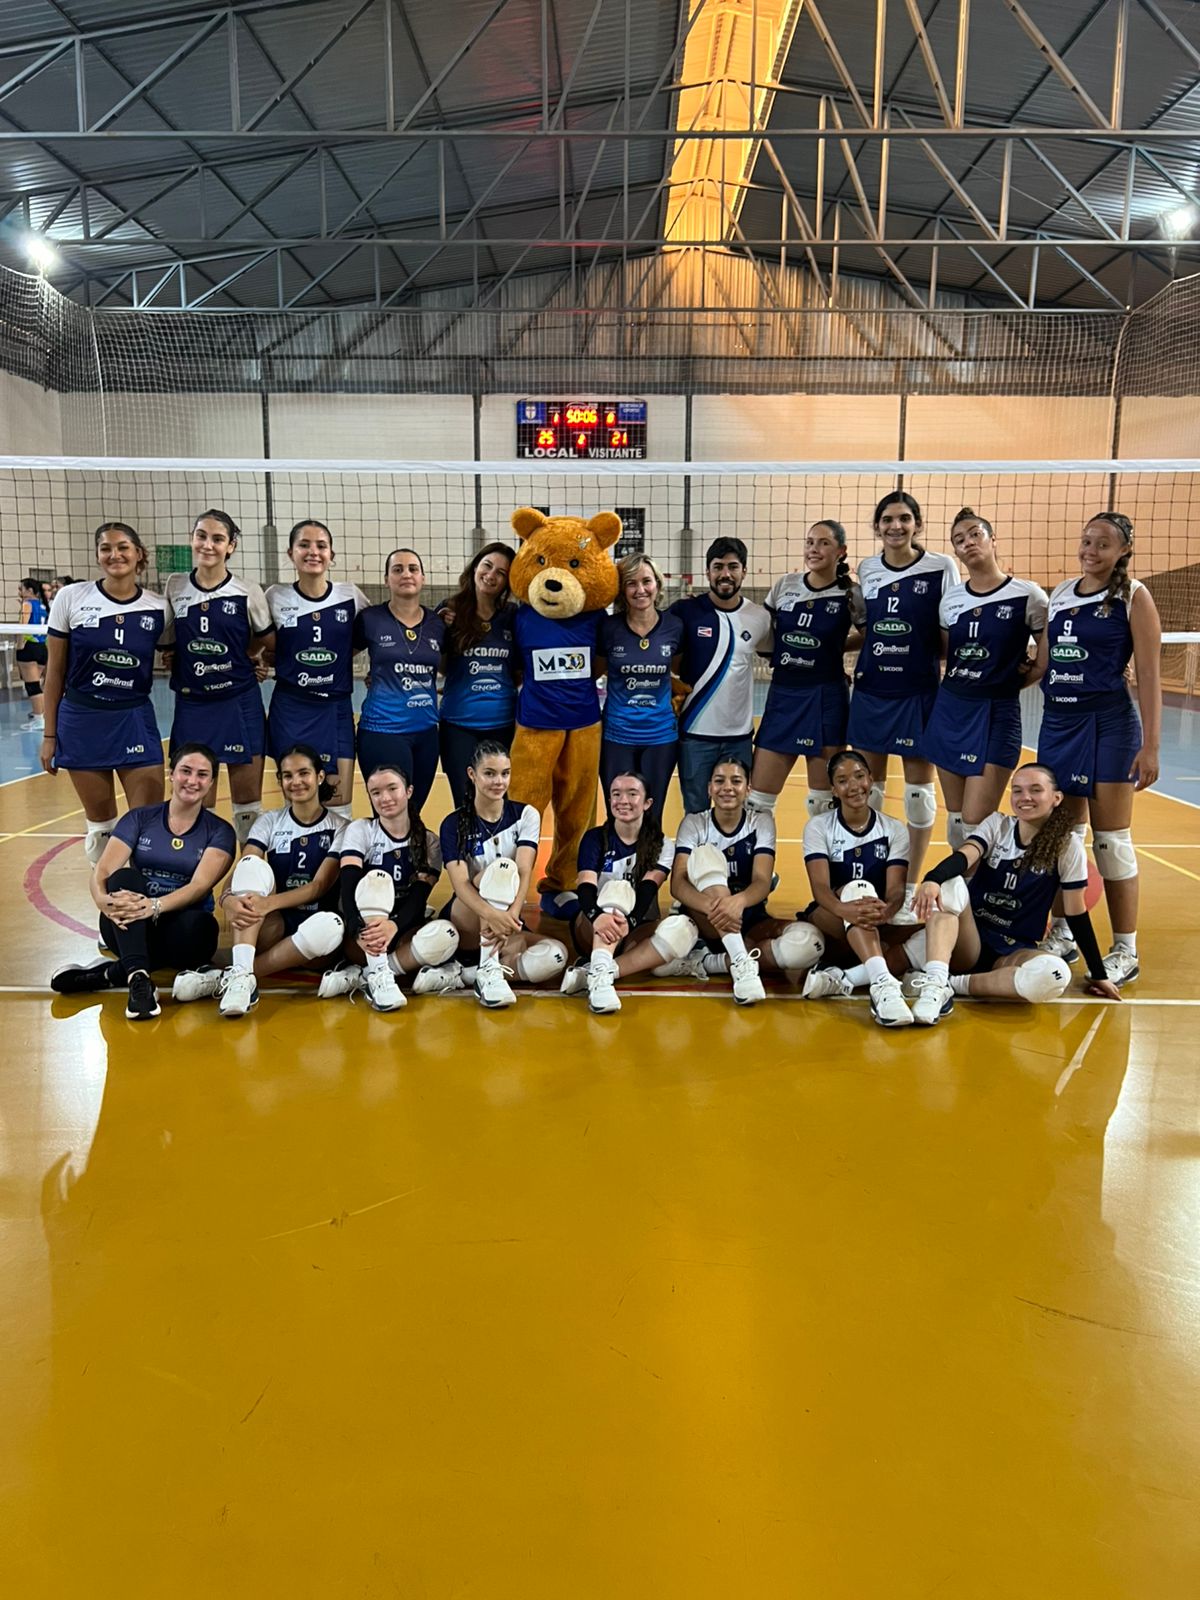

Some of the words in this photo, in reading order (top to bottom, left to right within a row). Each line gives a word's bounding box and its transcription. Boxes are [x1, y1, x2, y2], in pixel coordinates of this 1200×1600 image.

[538, 430, 555, 445] 25
[611, 430, 628, 446] 21
[525, 447, 579, 458] LOCAL
[588, 447, 642, 458] VISITANTE
[887, 596, 900, 613] 12
[200, 616, 209, 633] 8
[797, 612, 813, 628] 01
[876, 622, 907, 633] SADA
[1063, 619, 1073, 637] 9
[114, 628, 124, 645] 4
[313, 626, 322, 643] 3
[968, 621, 980, 639] 11
[191, 641, 223, 653] SADA
[786, 634, 815, 647] SADA
[98, 653, 134, 666] SADA
[300, 652, 333, 663] SADA
[1052, 648, 1082, 659] SADA
[297, 851, 306, 869] 2
[393, 864, 402, 881] 6
[852, 862, 864, 879] 13
[1003, 872, 1017, 890] 10
